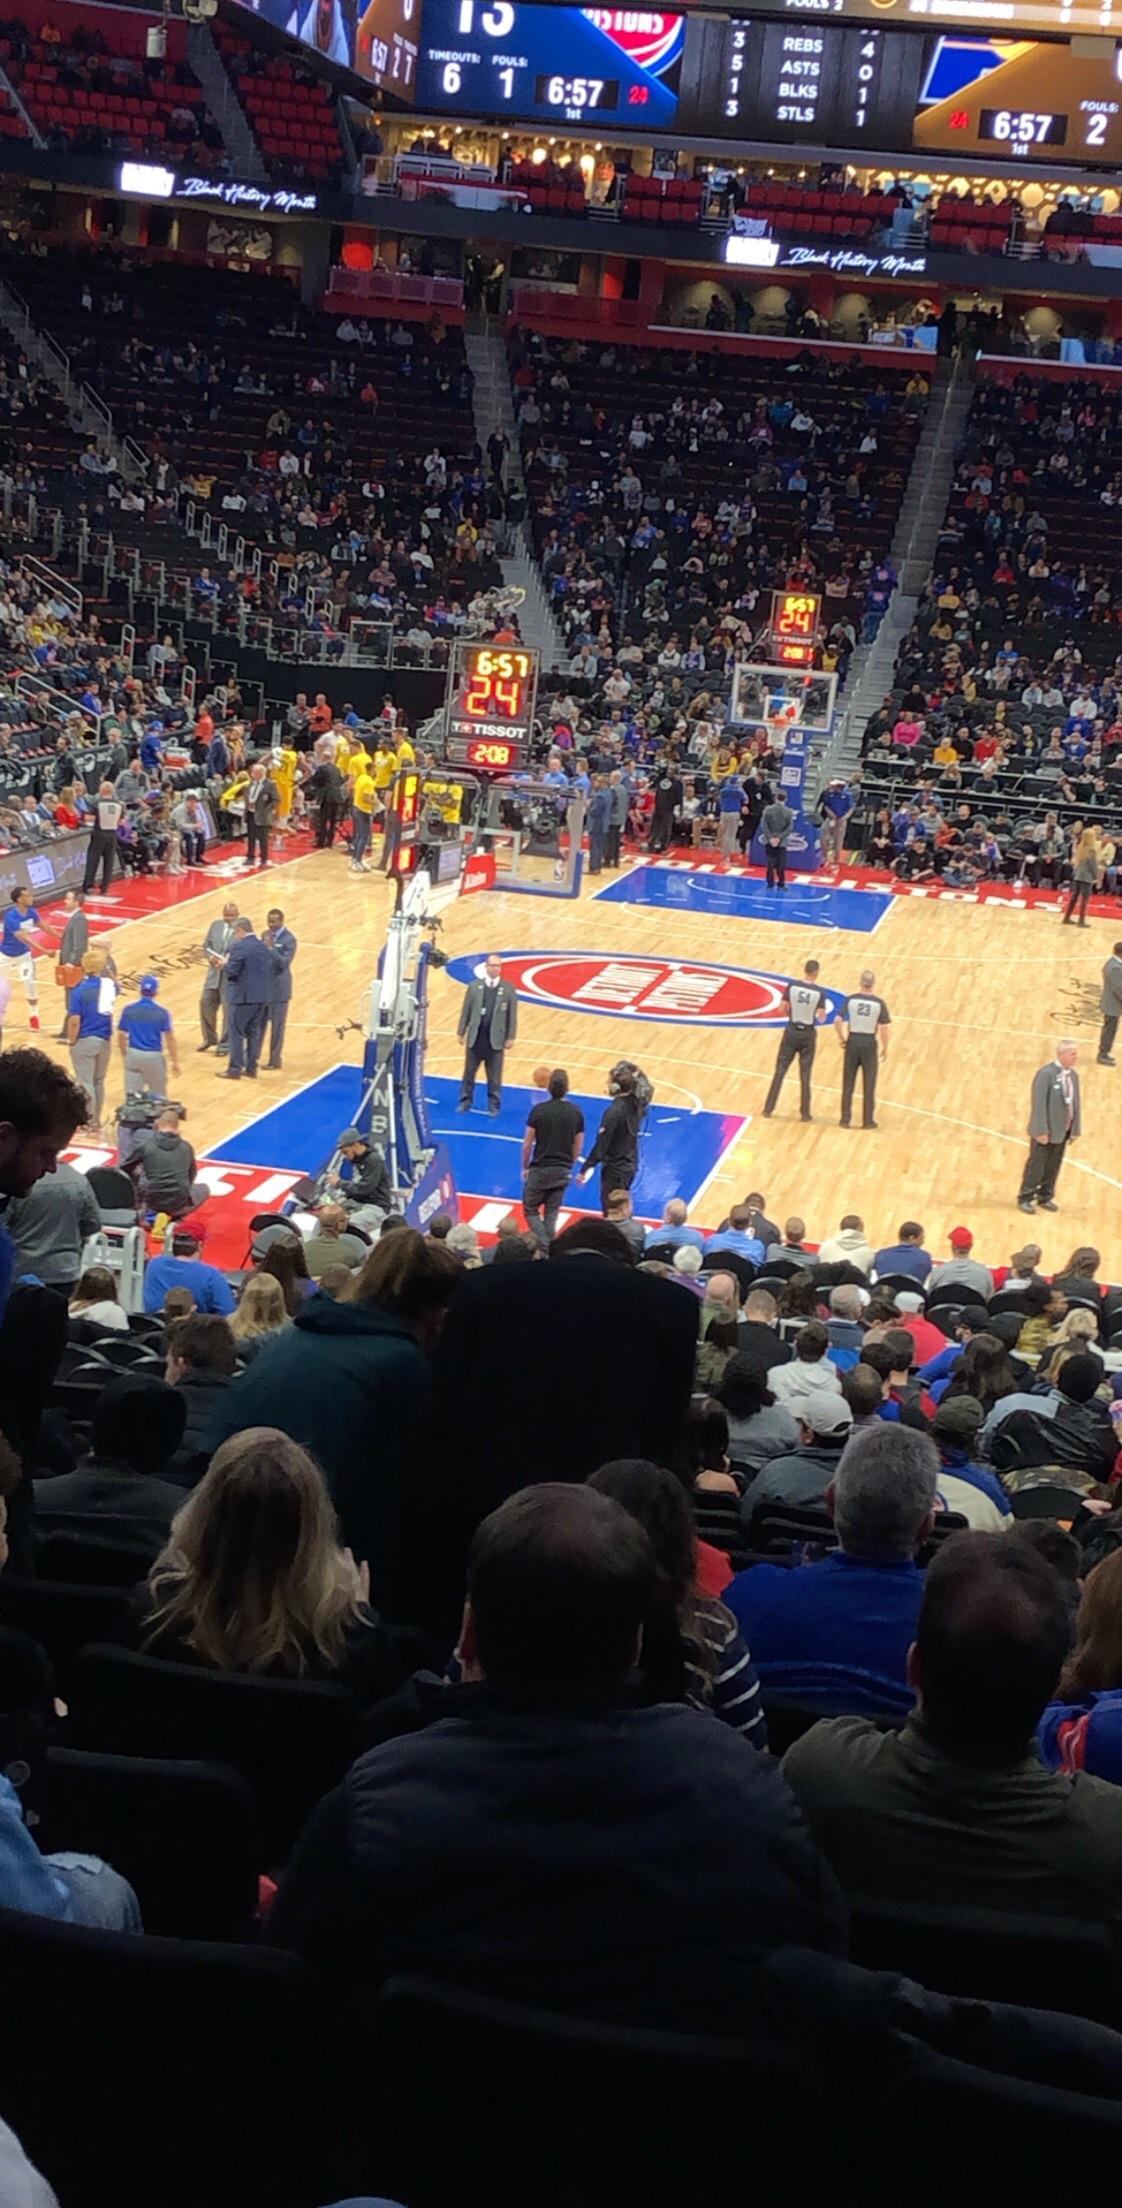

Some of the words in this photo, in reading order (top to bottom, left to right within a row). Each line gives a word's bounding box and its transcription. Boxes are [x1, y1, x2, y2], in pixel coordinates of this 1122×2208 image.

[429, 49, 480, 64] TIMEOUTS:
[492, 55, 528, 67] FOULS:
[734, 32, 745, 48] 3
[783, 37, 823, 53] REBS
[860, 41, 875, 58] 4
[443, 63, 461, 94] 6
[499, 68, 514, 98] 1
[731, 55, 743, 71] 5
[781, 60, 820, 75] ASTS
[859, 64, 873, 81] 0
[548, 76, 603, 107] 6:57
[628, 85, 648, 105] 24
[730, 78, 738, 94] 1
[779, 83, 818, 99] BLKS
[858, 88, 867, 104] 1
[726, 100, 738, 117] 3
[777, 105, 815, 122] STLS
[856, 110, 865, 127] 1
[1080, 101, 1119, 113] FOULS:
[949, 111, 968, 129] 24
[993, 112, 1053, 142] 6:57
[1086, 113, 1108, 145] 2
[176, 178, 223, 197] Black
[225, 183, 271, 212] History
[273, 190, 317, 213] Month
[781, 247, 829, 265] Black
[831, 251, 878, 276] History
[880, 255, 926, 277] Month
[780, 611, 809, 633] 24
[477, 651, 528, 677] 6:57
[467, 675, 518, 716] 24
[473, 723, 527, 739] TISSOT
[474, 744, 509, 765] 2:08
[791, 873, 1063, 913] PISTONS
[797, 991, 811, 1005] 54
[857, 1003, 871, 1017] 23
